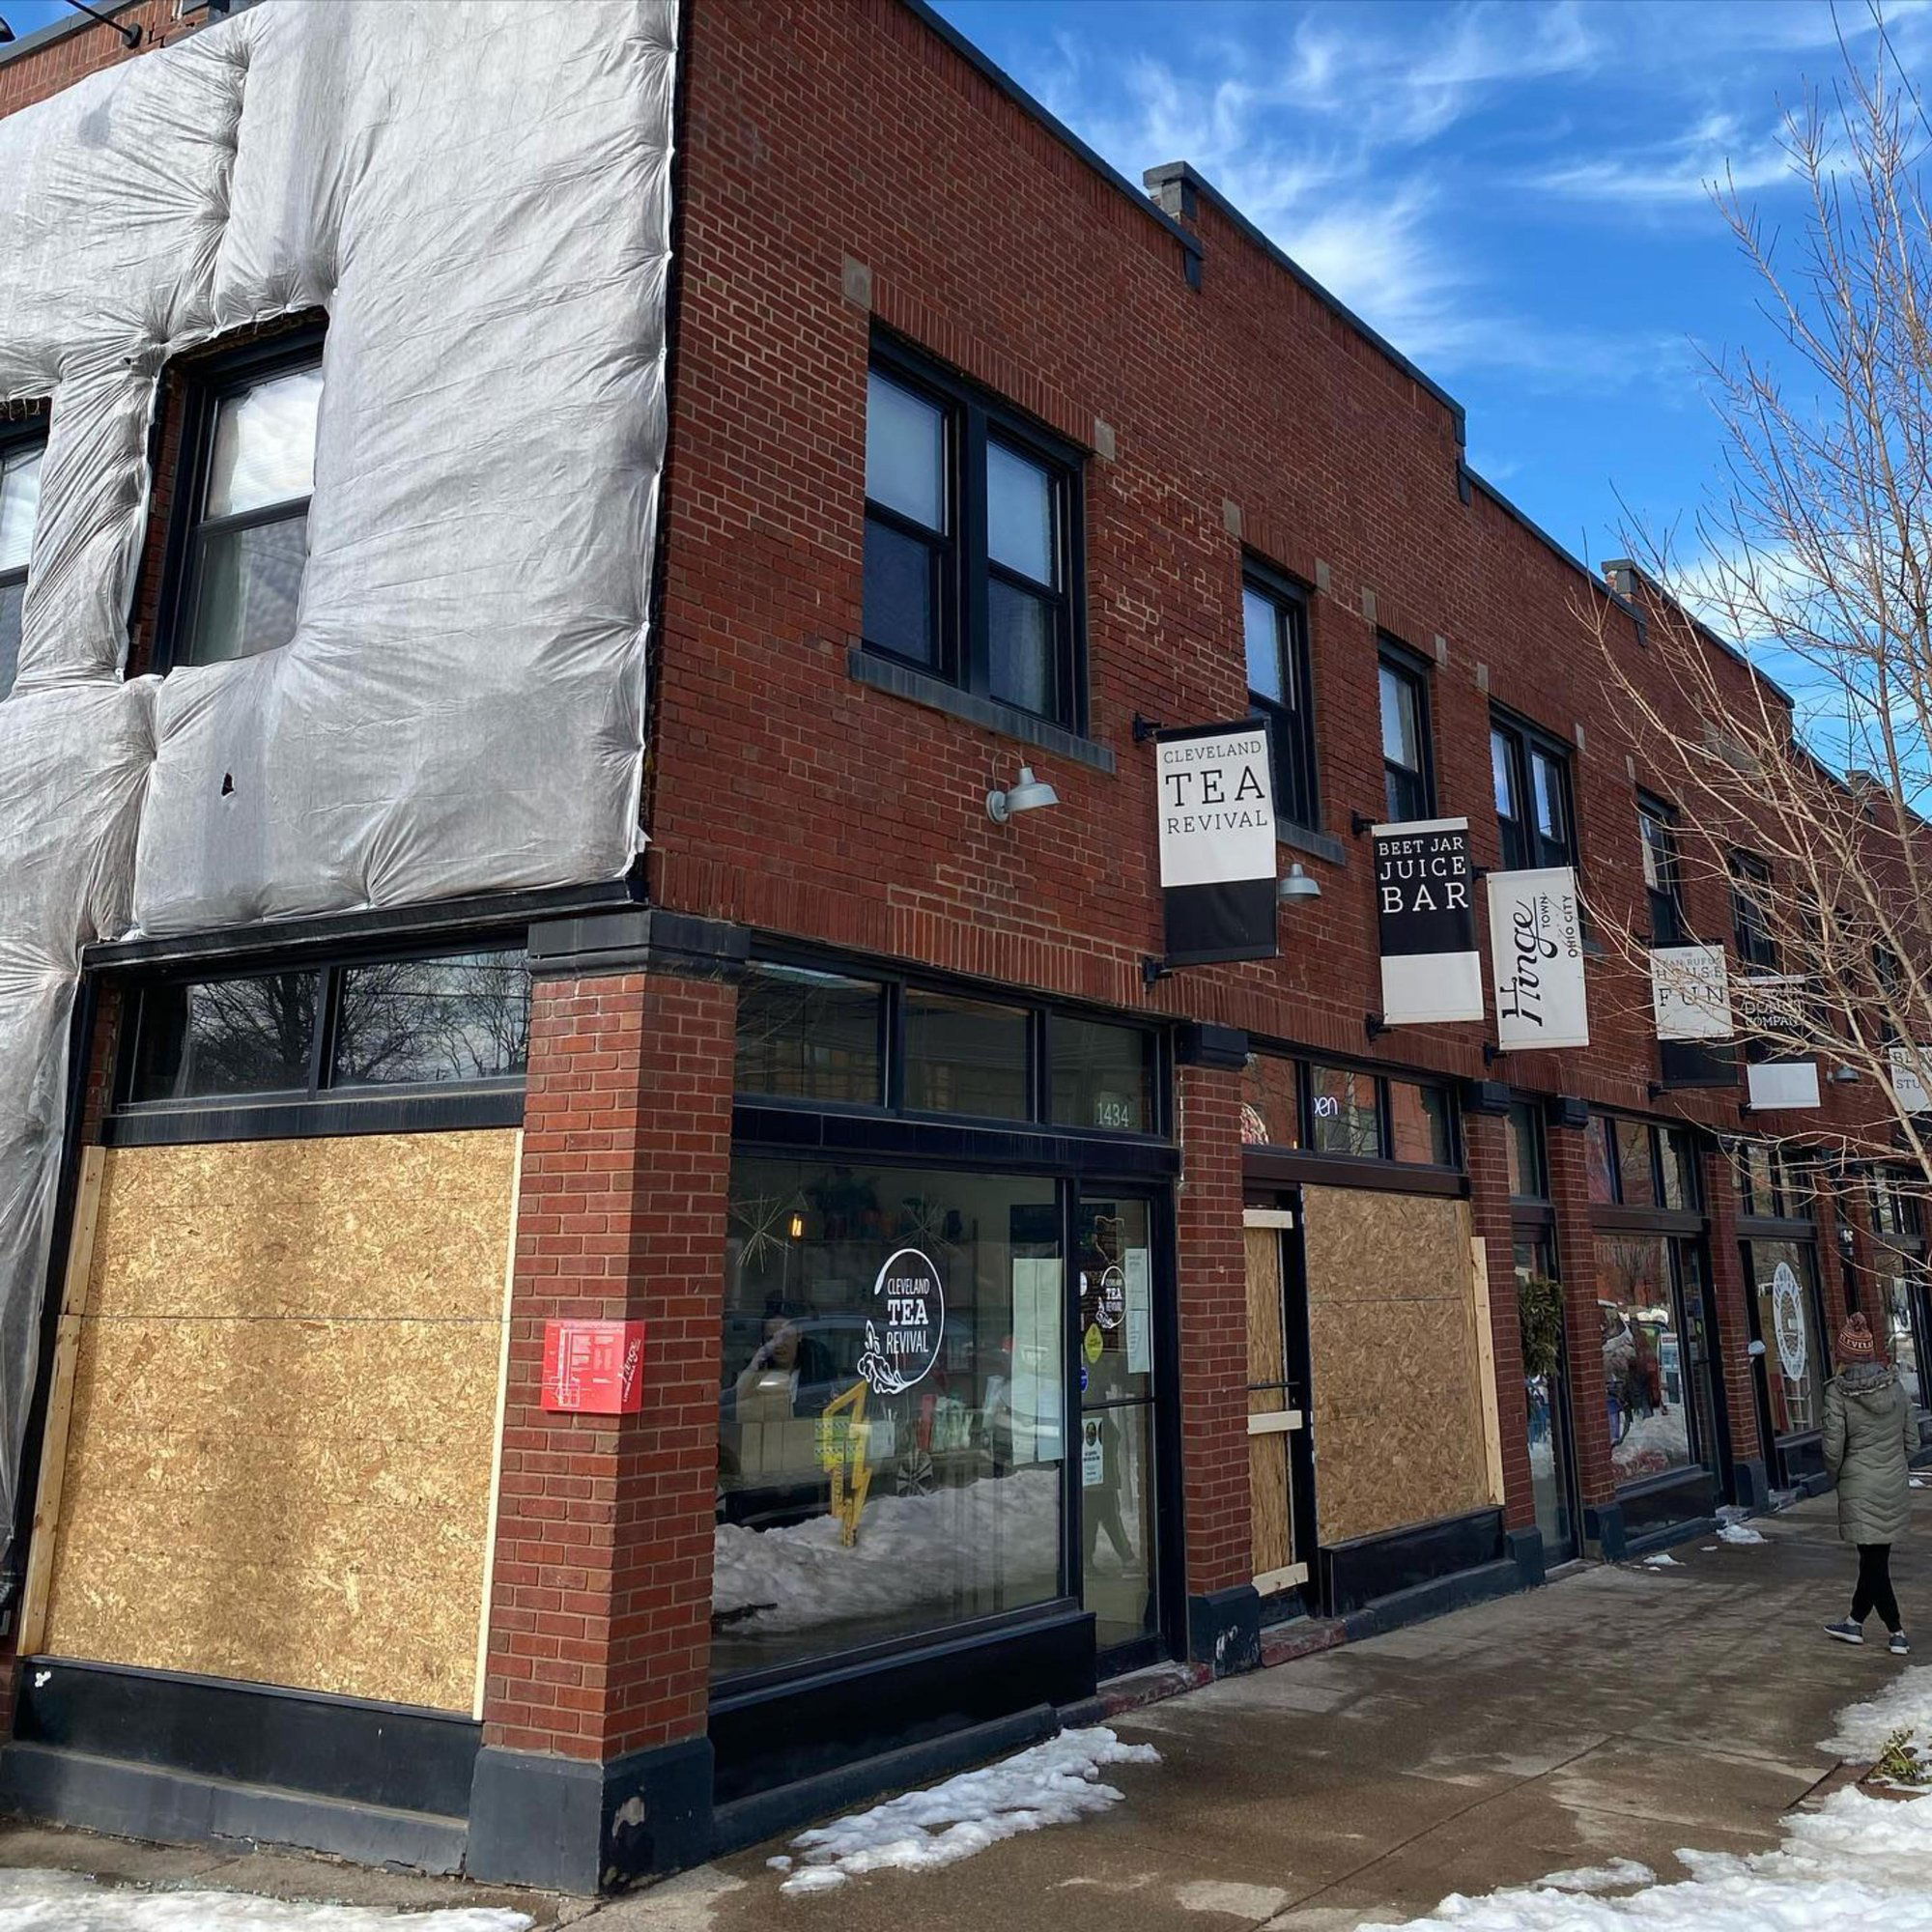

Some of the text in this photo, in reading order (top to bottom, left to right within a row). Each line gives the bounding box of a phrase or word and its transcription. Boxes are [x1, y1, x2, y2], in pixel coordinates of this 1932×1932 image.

[1164, 740, 1263, 763] CLEVELAND
[1165, 765, 1265, 807] TEA
[1167, 810, 1268, 835] REVIVAL
[1378, 837, 1464, 856] BEET JAR
[1379, 856, 1466, 880] JUICE
[1381, 882, 1469, 914] BAR
[1540, 895, 1550, 929] TOWN
[1562, 895, 1578, 958] OHIO CITY
[1499, 896, 1558, 1027] Hinge
[1658, 984, 1724, 1007] FUN
[1745, 1014, 1804, 1027] COMPAN
[1097, 1102, 1129, 1127] 1434
[887, 1277, 931, 1295] CLEVELAND
[1105, 1287, 1122, 1300] TEA
[887, 1298, 929, 1326] TEA
[886, 1330, 929, 1354] REVIVAL
